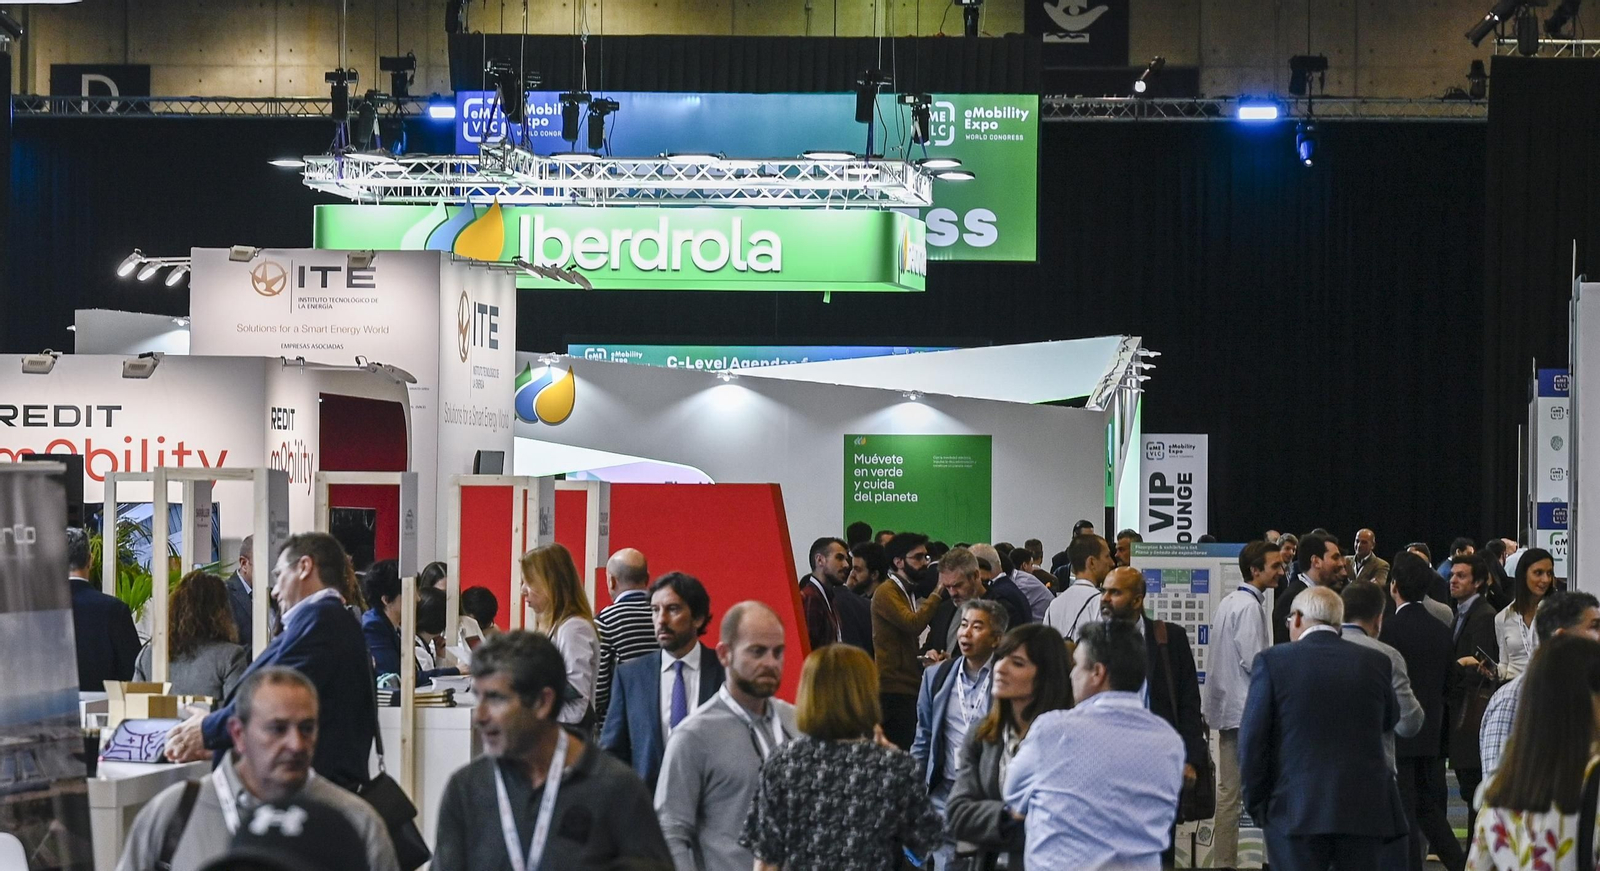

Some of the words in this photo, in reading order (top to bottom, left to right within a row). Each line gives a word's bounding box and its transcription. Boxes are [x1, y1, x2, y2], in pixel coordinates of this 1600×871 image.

[929, 111, 946, 122] ME
[964, 106, 1029, 122] eMobility
[930, 124, 946, 136] LC
[965, 119, 999, 133] Expo
[965, 133, 988, 141] WORLD
[519, 214, 782, 272] Iberdrola
[298, 265, 376, 289] ITE
[307, 302, 333, 310] ENERGÍA
[329, 296, 370, 304] TECNOLÓGICO
[236, 323, 277, 333] Solutions
[279, 323, 291, 333] for
[301, 324, 328, 334] Smart
[330, 324, 361, 336] Energy
[363, 325, 390, 334] World
[473, 301, 499, 350] ITE
[667, 355, 727, 369] C-Level
[0, 405, 122, 427] REDIT
[271, 407, 296, 431] REDIT
[1168, 443, 1196, 451] eMobility
[854, 453, 904, 465] Muévete
[854, 468, 868, 477] en
[870, 466, 903, 477] verde
[854, 480, 861, 491] y
[863, 478, 895, 490] cuida
[854, 491, 872, 502] del
[874, 491, 918, 504] planeta
[1149, 471, 1174, 533] VIP
[1177, 472, 1192, 543] OUNGE
